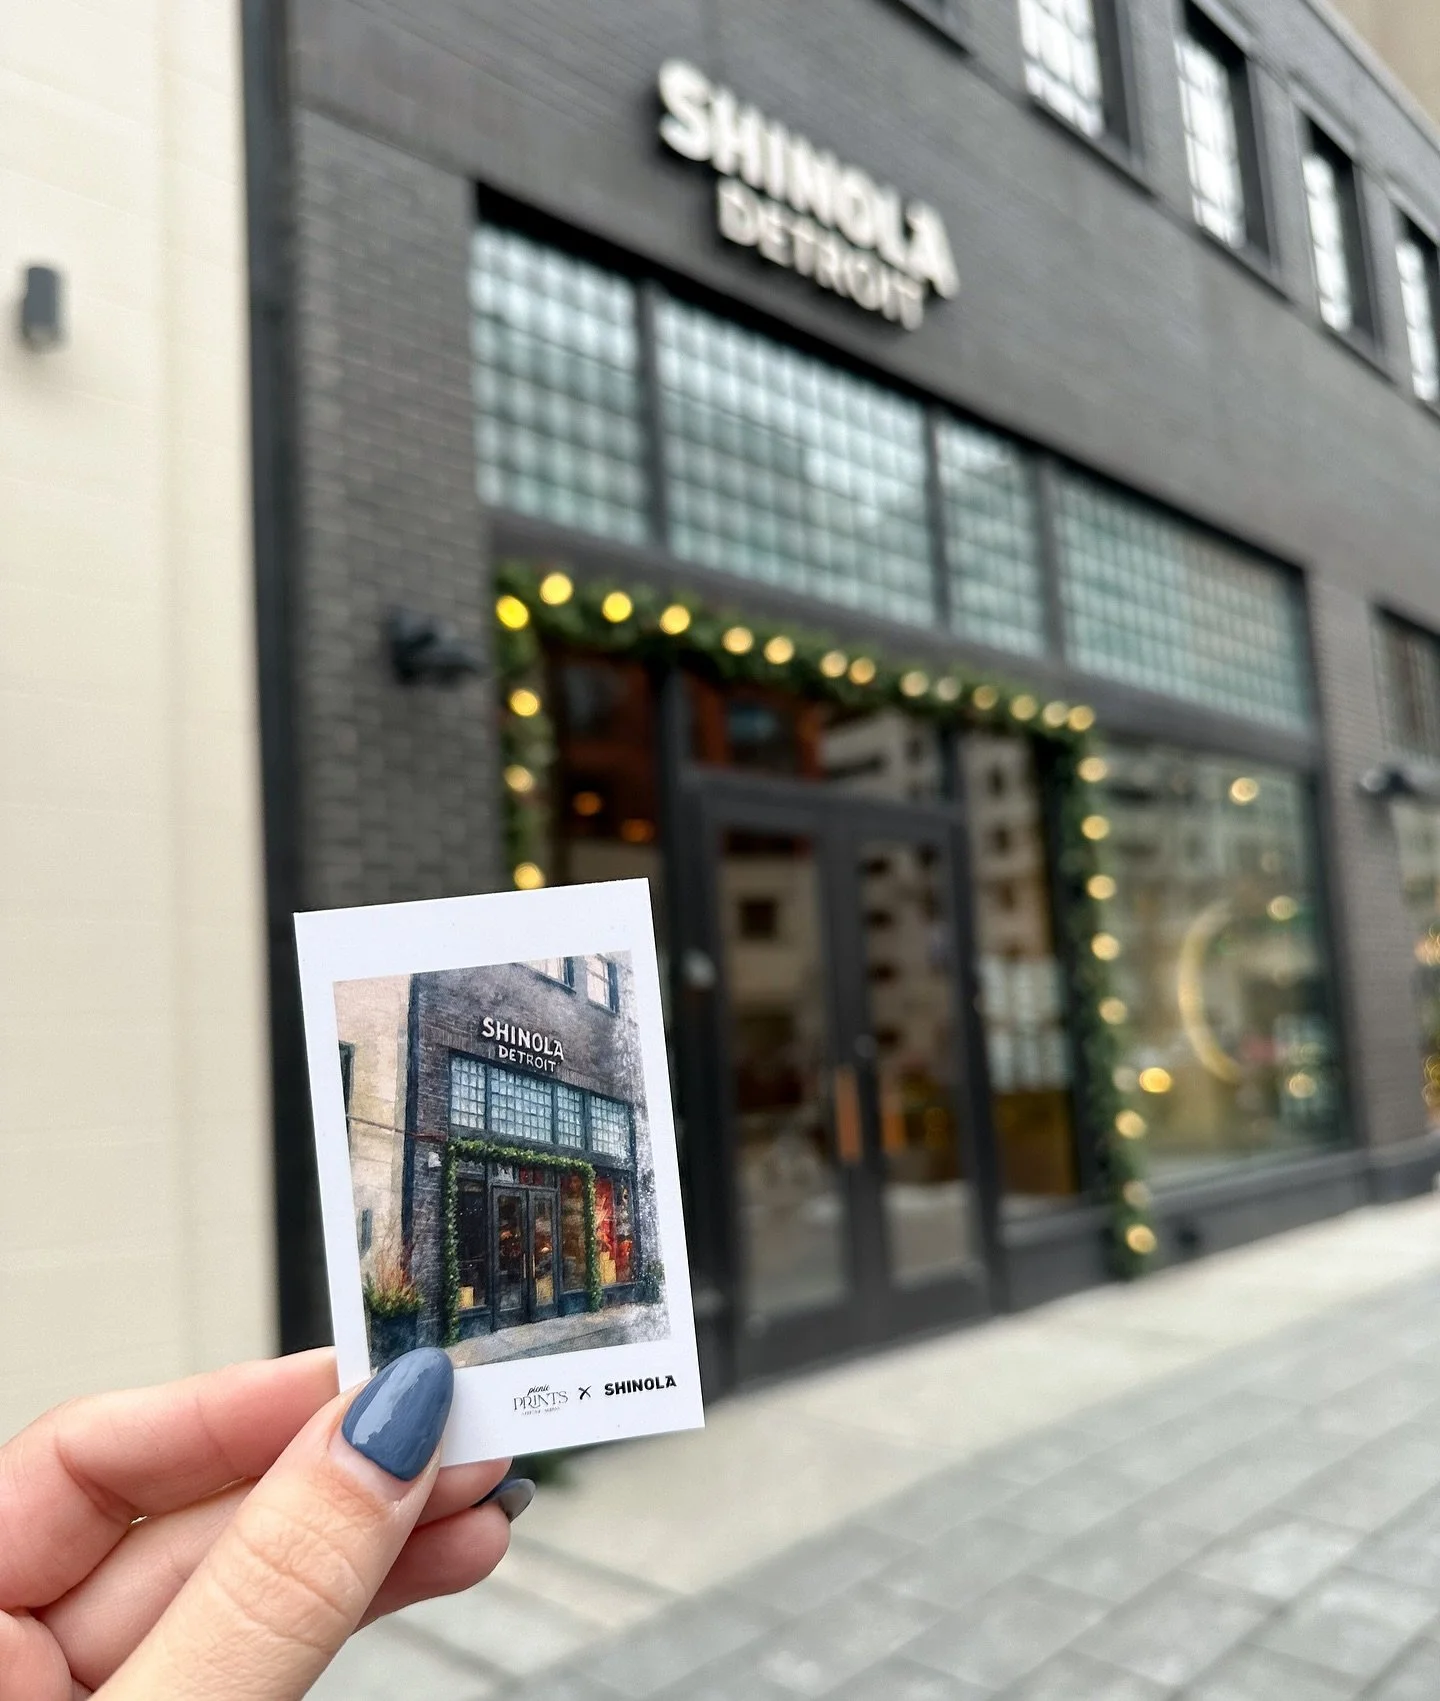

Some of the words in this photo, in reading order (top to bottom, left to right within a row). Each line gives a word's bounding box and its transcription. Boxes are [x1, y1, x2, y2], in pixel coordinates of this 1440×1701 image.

[659, 58, 960, 300] SHINOLA
[717, 175, 924, 331] DETROIT
[482, 1016, 564, 1061] SHINOLA
[498, 1044, 556, 1073] DETROIT
[513, 1390, 569, 1411] PRINTS
[604, 1375, 677, 1396] SHINOLA
